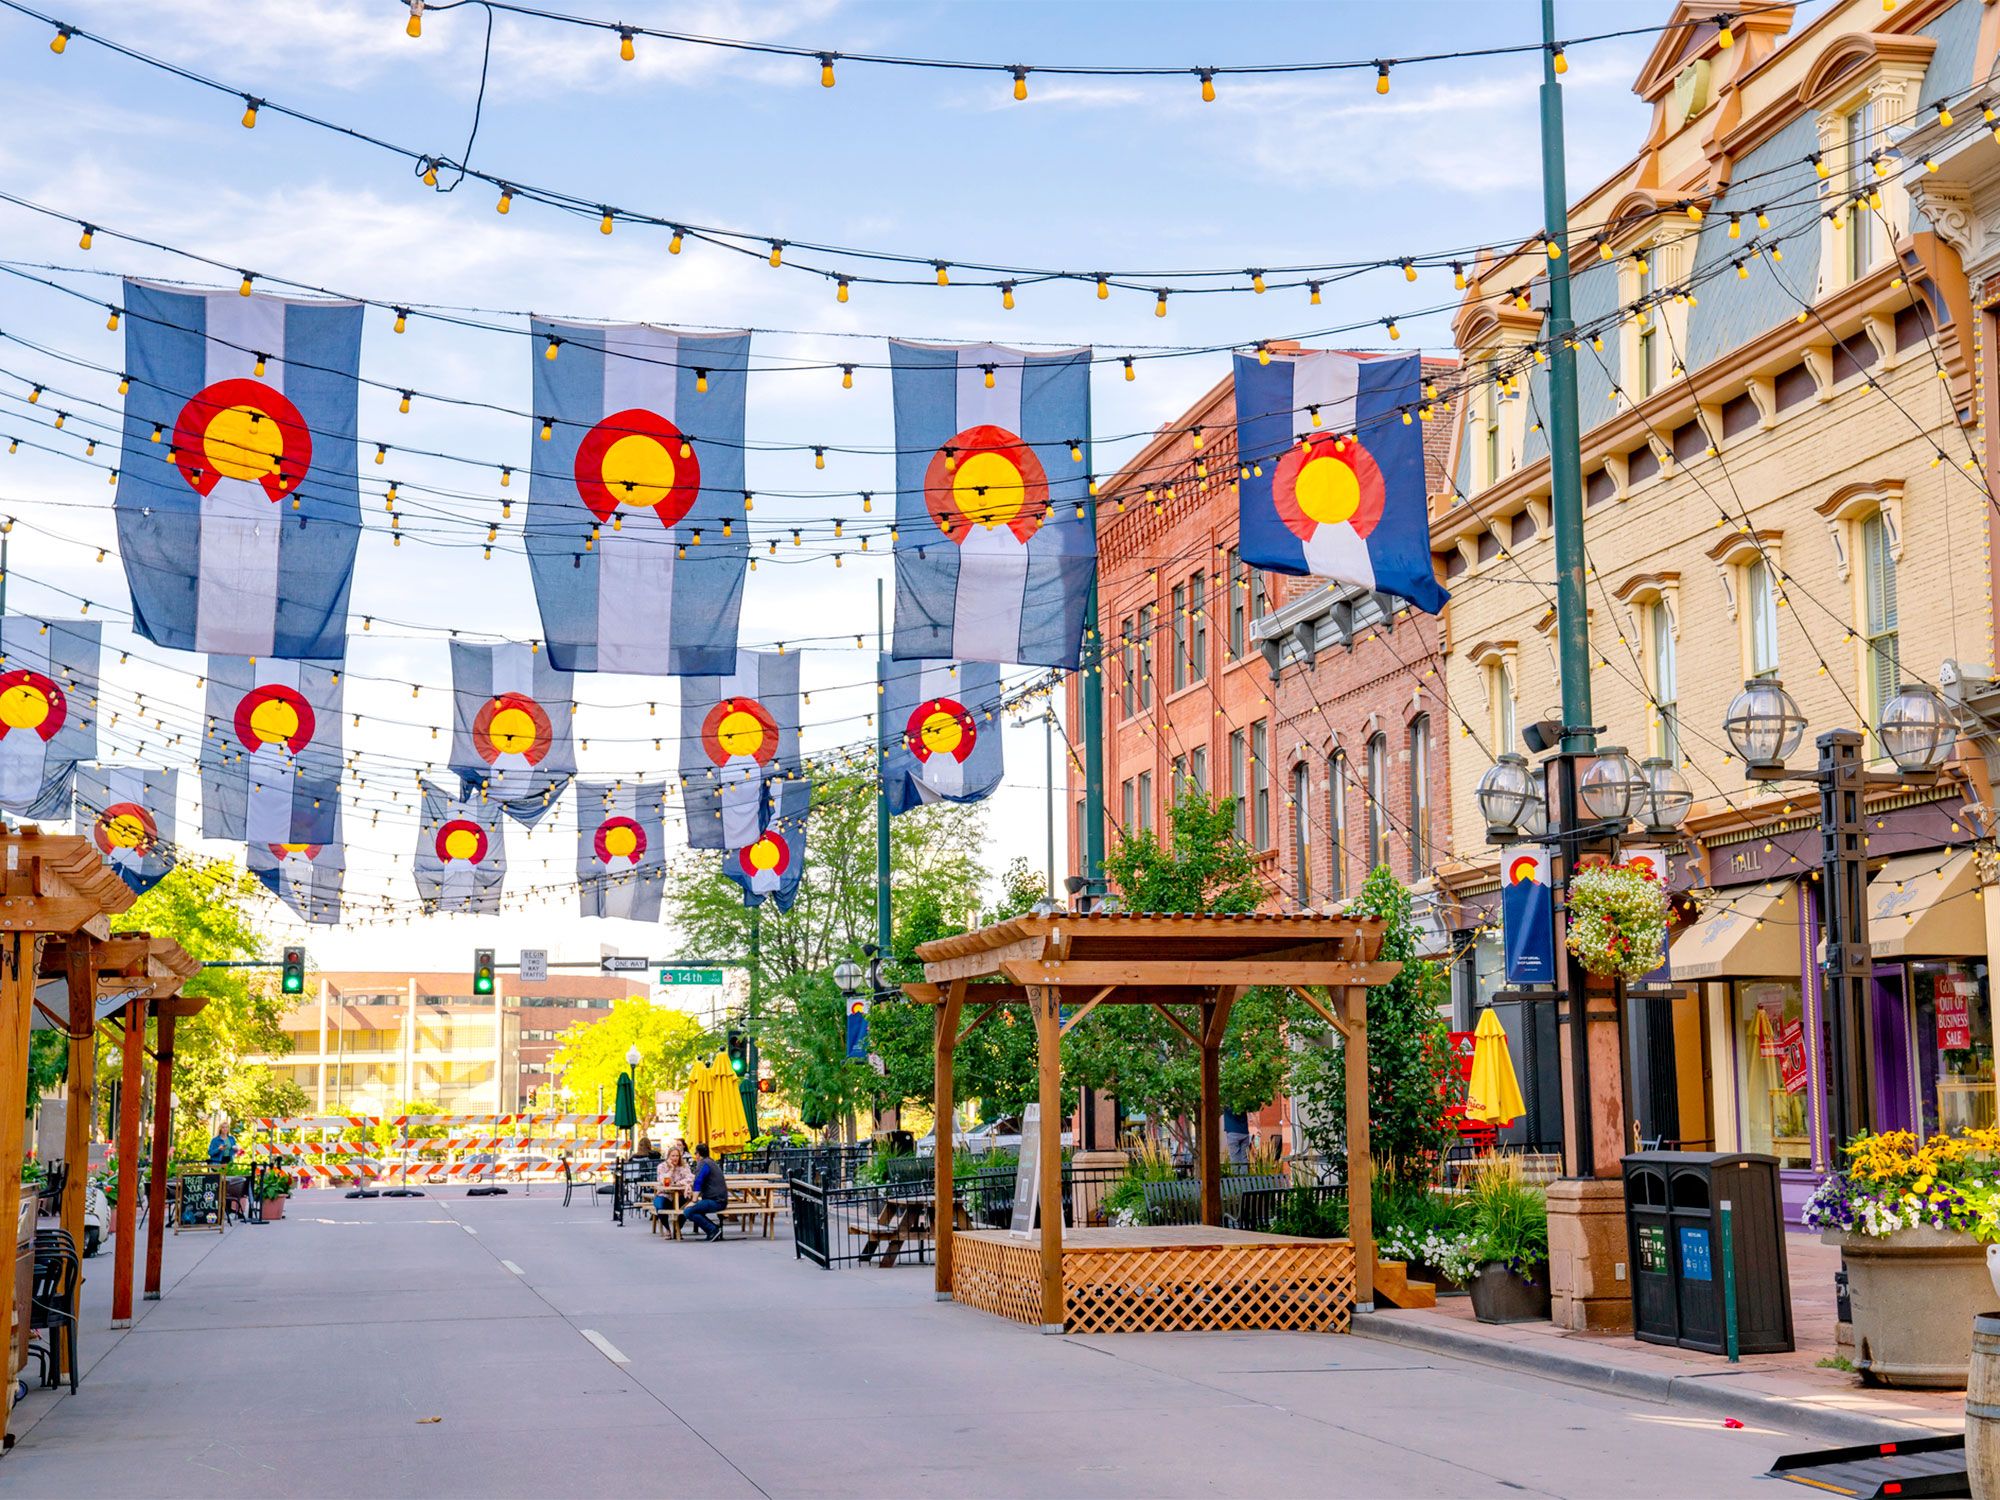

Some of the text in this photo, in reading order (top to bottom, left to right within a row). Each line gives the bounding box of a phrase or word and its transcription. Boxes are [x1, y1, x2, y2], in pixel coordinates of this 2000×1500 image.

[1730, 851, 1762, 874] HALL
[678, 972, 703, 983] 14th
[1940, 995, 1964, 1010] OUT OF
[1938, 1013, 1968, 1028] BUSINESS
[1946, 1031, 1962, 1045] SALE
[183, 1176, 205, 1184] TREAT
[205, 1183, 218, 1191] PUP
[183, 1193, 202, 1204] SHOP
